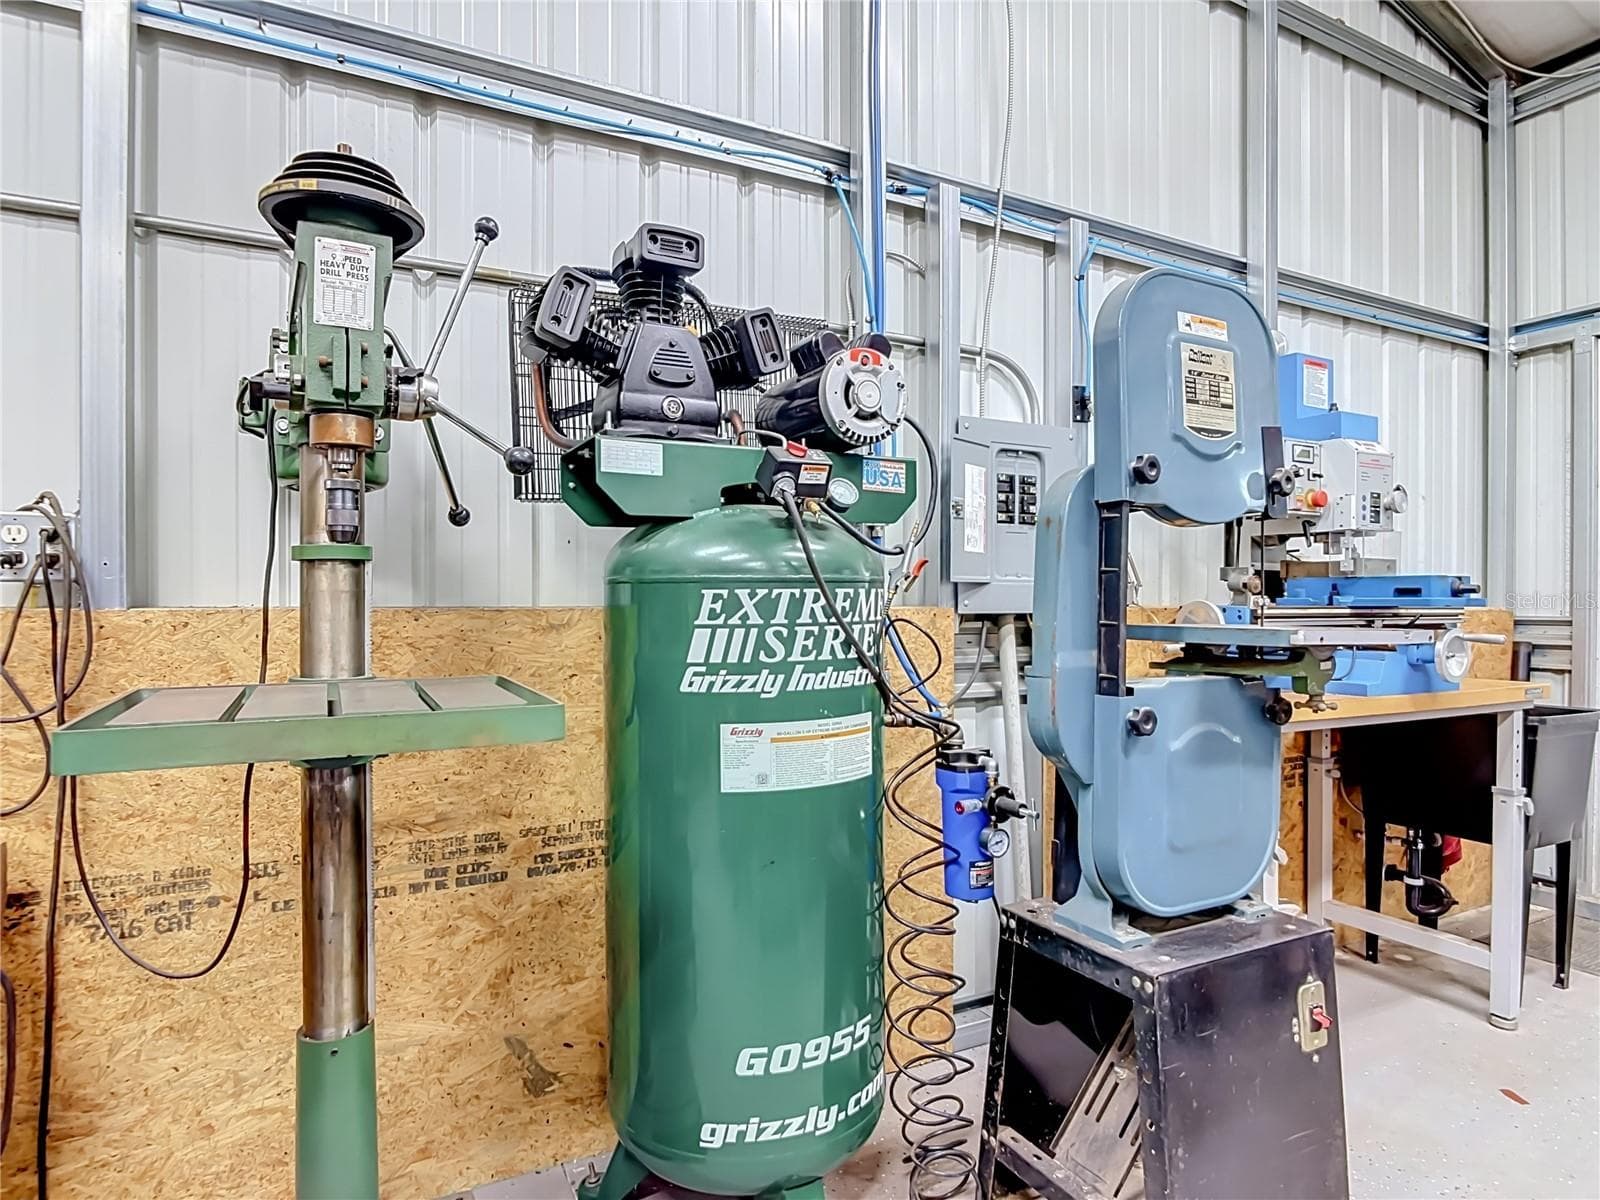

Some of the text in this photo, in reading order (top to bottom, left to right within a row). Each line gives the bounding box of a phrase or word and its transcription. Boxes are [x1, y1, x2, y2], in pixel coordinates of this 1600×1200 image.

[320, 259, 370, 273] HEAVY DUTY
[342, 255, 362, 265] PEED
[320, 267, 369, 282] DRILL PRESS
[865, 468, 902, 488] USA
[680, 665, 785, 699] Grizzly
[730, 726, 764, 738] Grizzly
